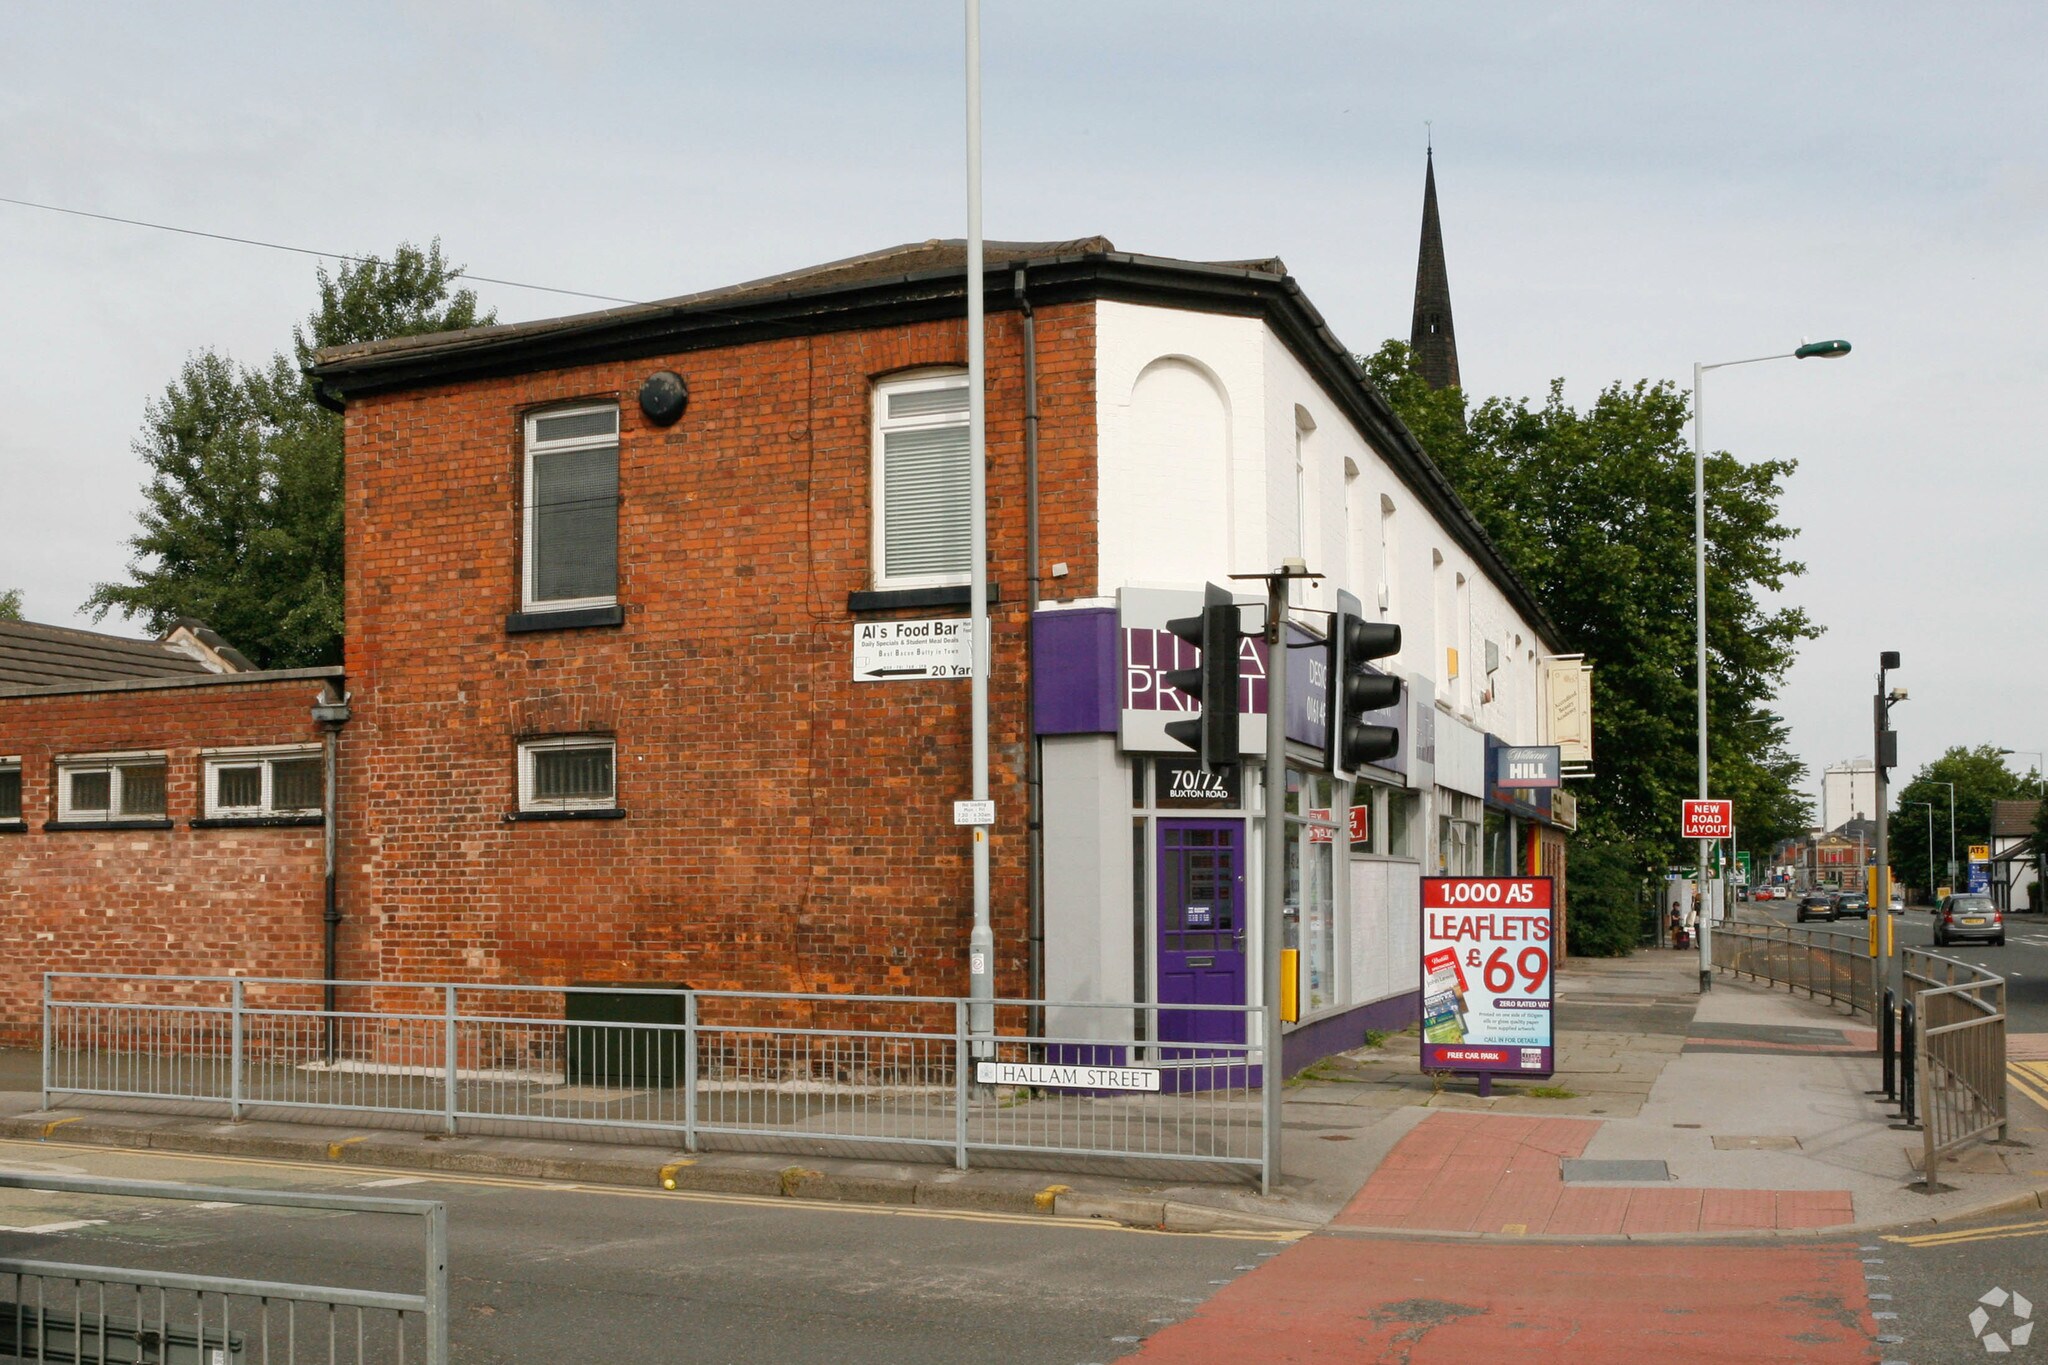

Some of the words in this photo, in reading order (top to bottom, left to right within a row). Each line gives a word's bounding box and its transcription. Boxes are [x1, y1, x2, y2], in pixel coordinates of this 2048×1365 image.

[896, 622, 930, 638] Food
[934, 622, 959, 636] Bar
[1127, 628, 1266, 674] LITA
[932, 665, 946, 676] 20
[950, 664, 972, 676] Yar
[1508, 748, 1548, 761] William
[1510, 763, 1546, 779] HILL
[1171, 770, 1223, 790] 70/72
[1170, 789, 1204, 798] BUXTON
[1205, 789, 1228, 798] ROAD
[1694, 805, 1720, 813] NEW
[1692, 815, 1722, 823] ROAD
[1686, 825, 1727, 833] LAYOUT
[1441, 883, 1501, 904] 1,000
[1505, 884, 1534, 904] A5
[1429, 913, 1550, 942] LEAFLETS
[1480, 1052, 1499, 1060] PARK
[1004, 1066, 1077, 1085] HALLAM
[1087, 1069, 1152, 1088] STREET
